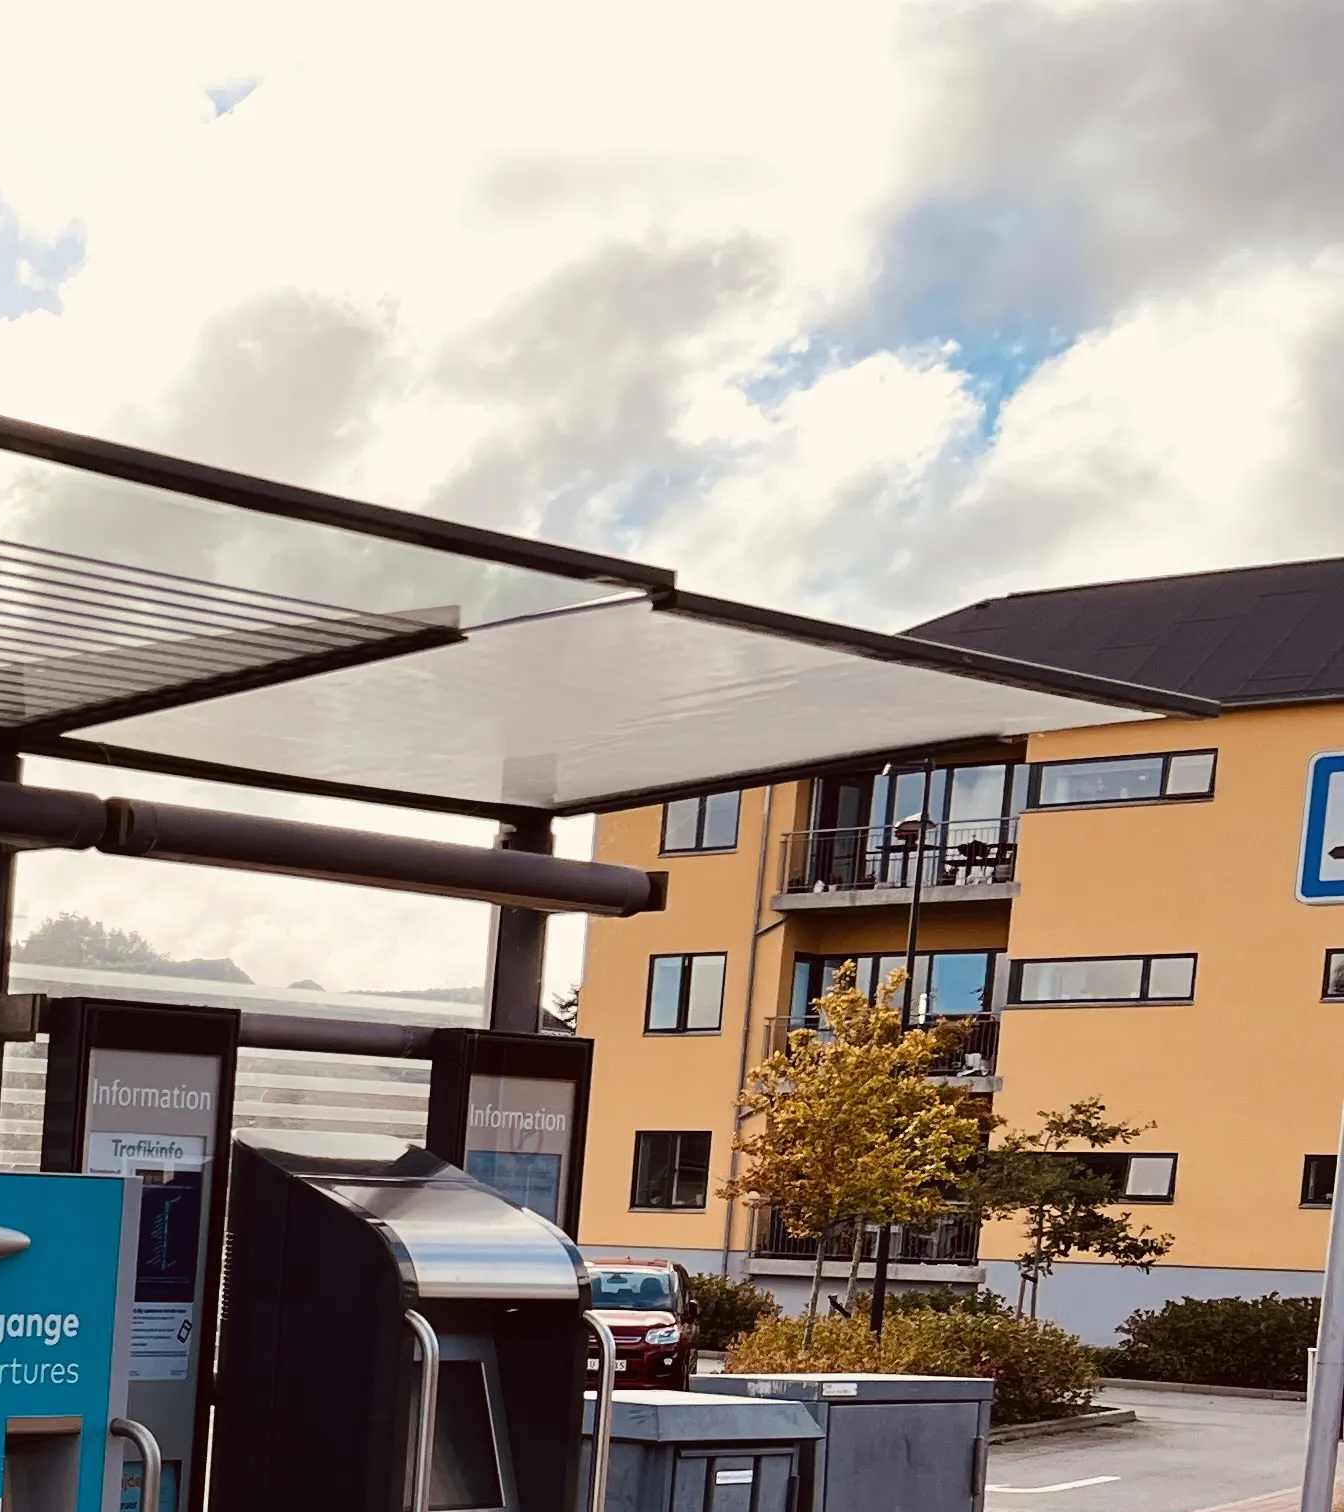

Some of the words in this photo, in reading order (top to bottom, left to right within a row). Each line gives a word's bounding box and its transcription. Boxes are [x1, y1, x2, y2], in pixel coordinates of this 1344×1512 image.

[92, 1079, 211, 1110] Information
[470, 1103, 565, 1131] Information
[112, 1139, 183, 1159] Trafikinfo
